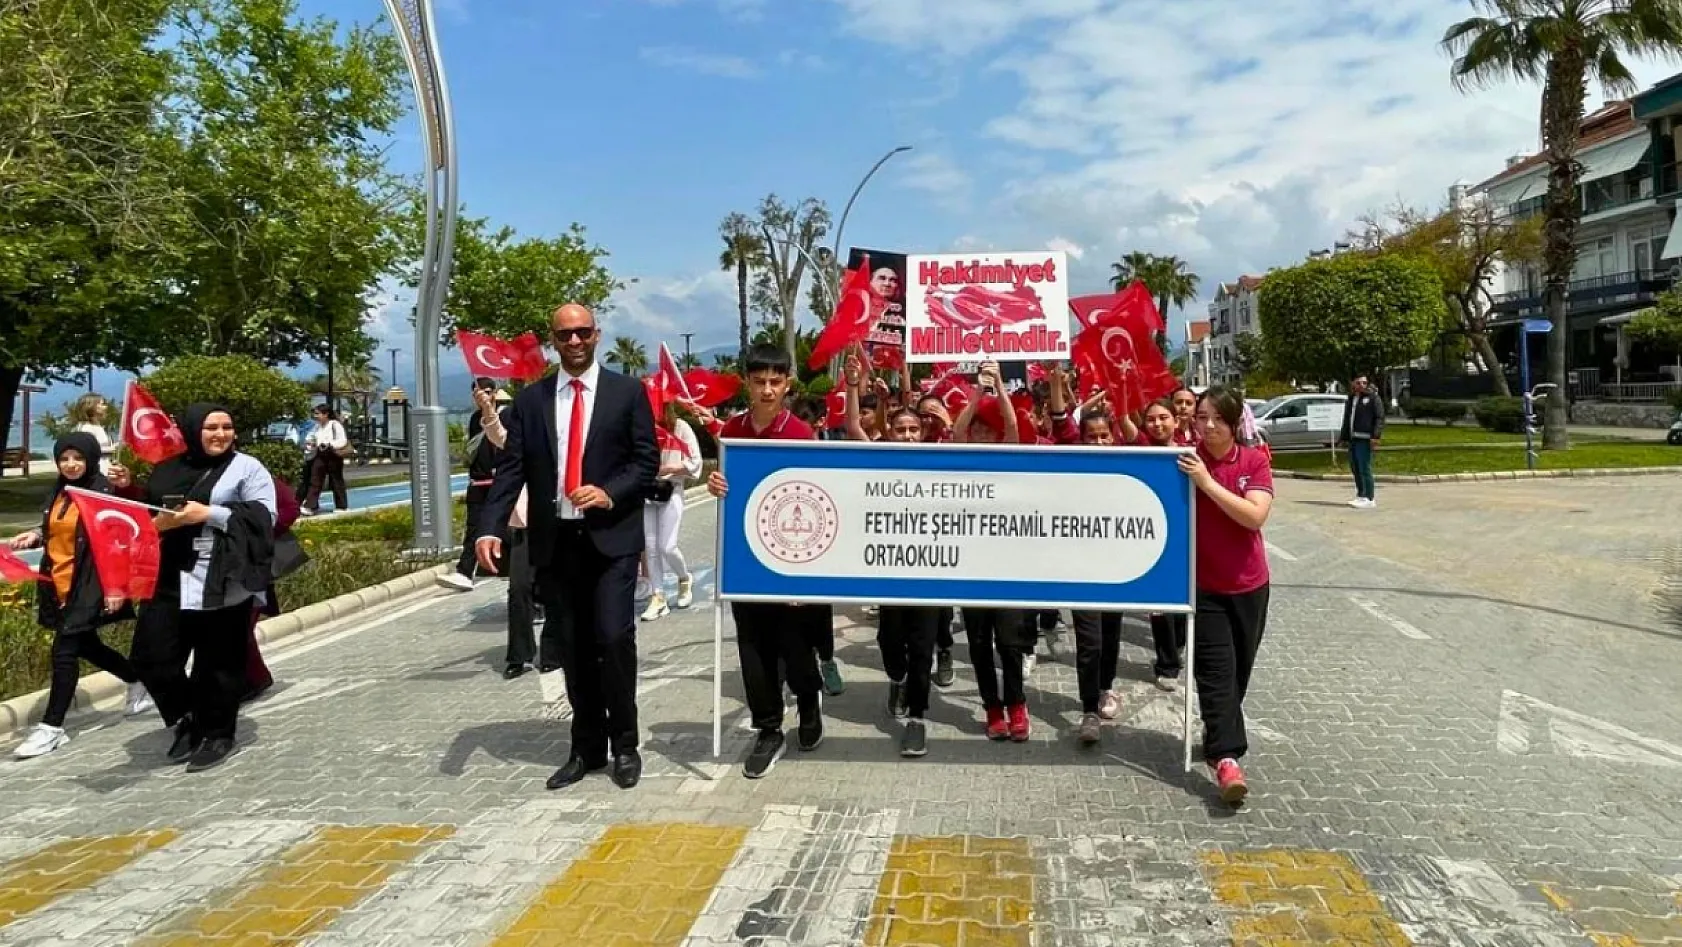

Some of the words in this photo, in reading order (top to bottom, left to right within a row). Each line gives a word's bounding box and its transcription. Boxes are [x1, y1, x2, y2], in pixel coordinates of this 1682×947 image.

[919, 257, 1056, 288] Hakimiyet
[911, 324, 1067, 355] Milletindir.
[865, 480, 995, 499] MUĞLA-FETHİYE
[865, 509, 928, 535] FETHİYE
[931, 508, 976, 541] ŞEHİT
[979, 509, 1048, 538] FERAMİL
[1051, 514, 1112, 539] FERHAT
[1115, 516, 1156, 540] KAYA
[864, 543, 960, 568] ORTAOKULU
